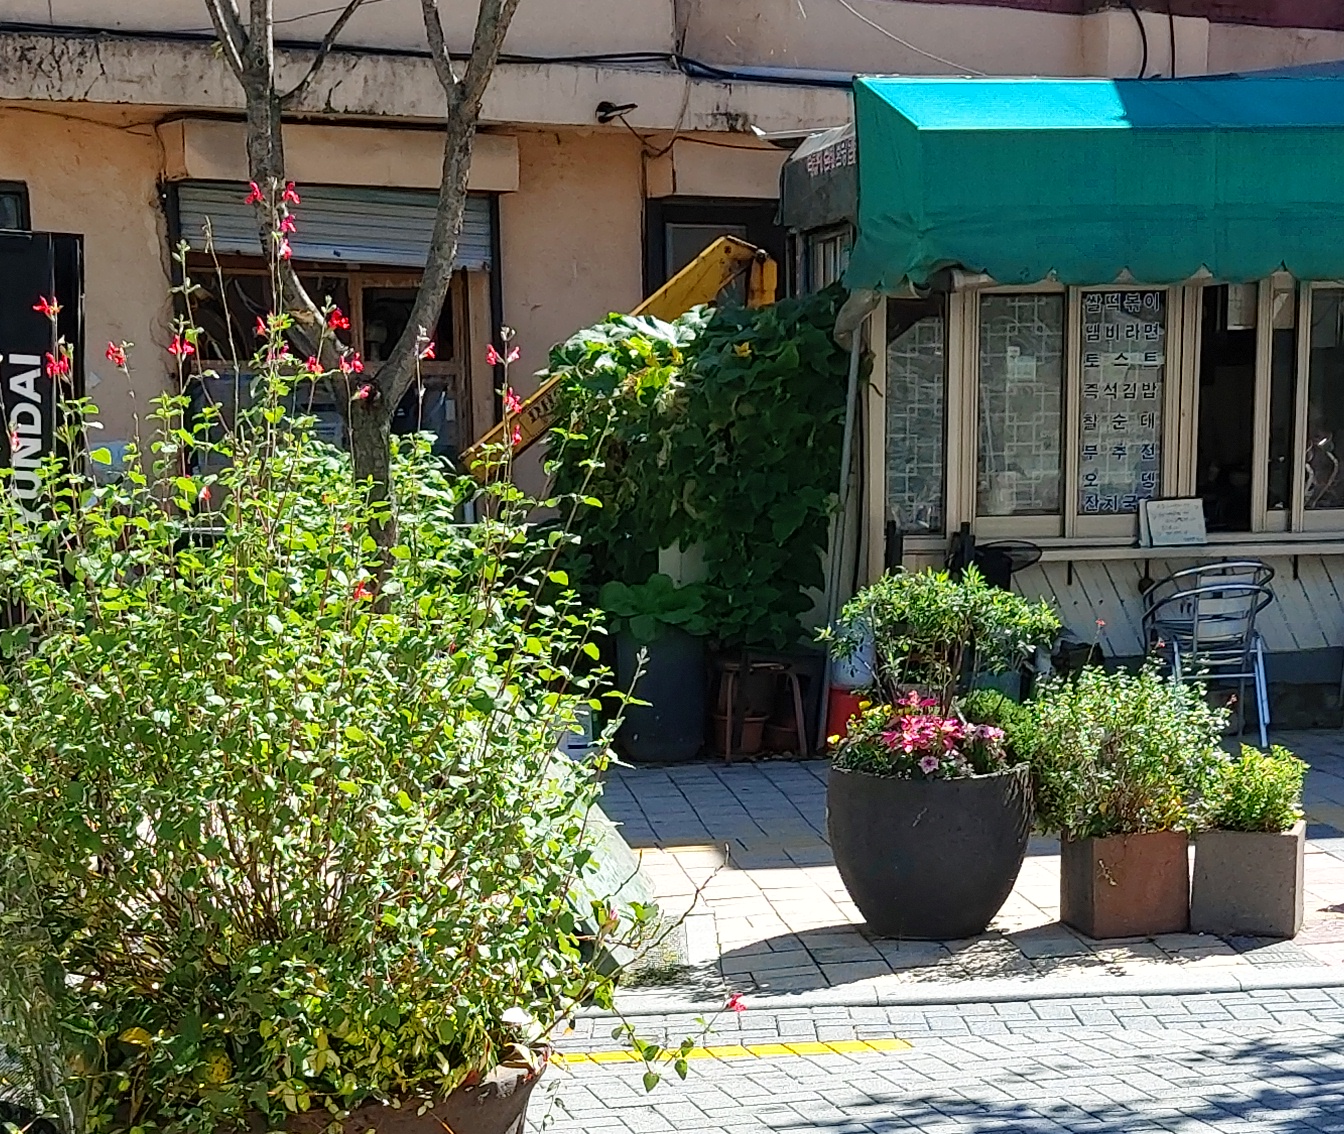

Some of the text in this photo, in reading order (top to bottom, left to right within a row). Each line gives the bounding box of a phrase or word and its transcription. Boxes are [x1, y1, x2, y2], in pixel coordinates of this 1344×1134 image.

[1086, 292, 1160, 313] 쌀떡볶이
[1086, 322, 1160, 342] 냄비라면
[1084, 352, 1160, 369] 토스트
[1084, 382, 1157, 400] 즉석김밥
[1084, 494, 1154, 512] 잔치국
